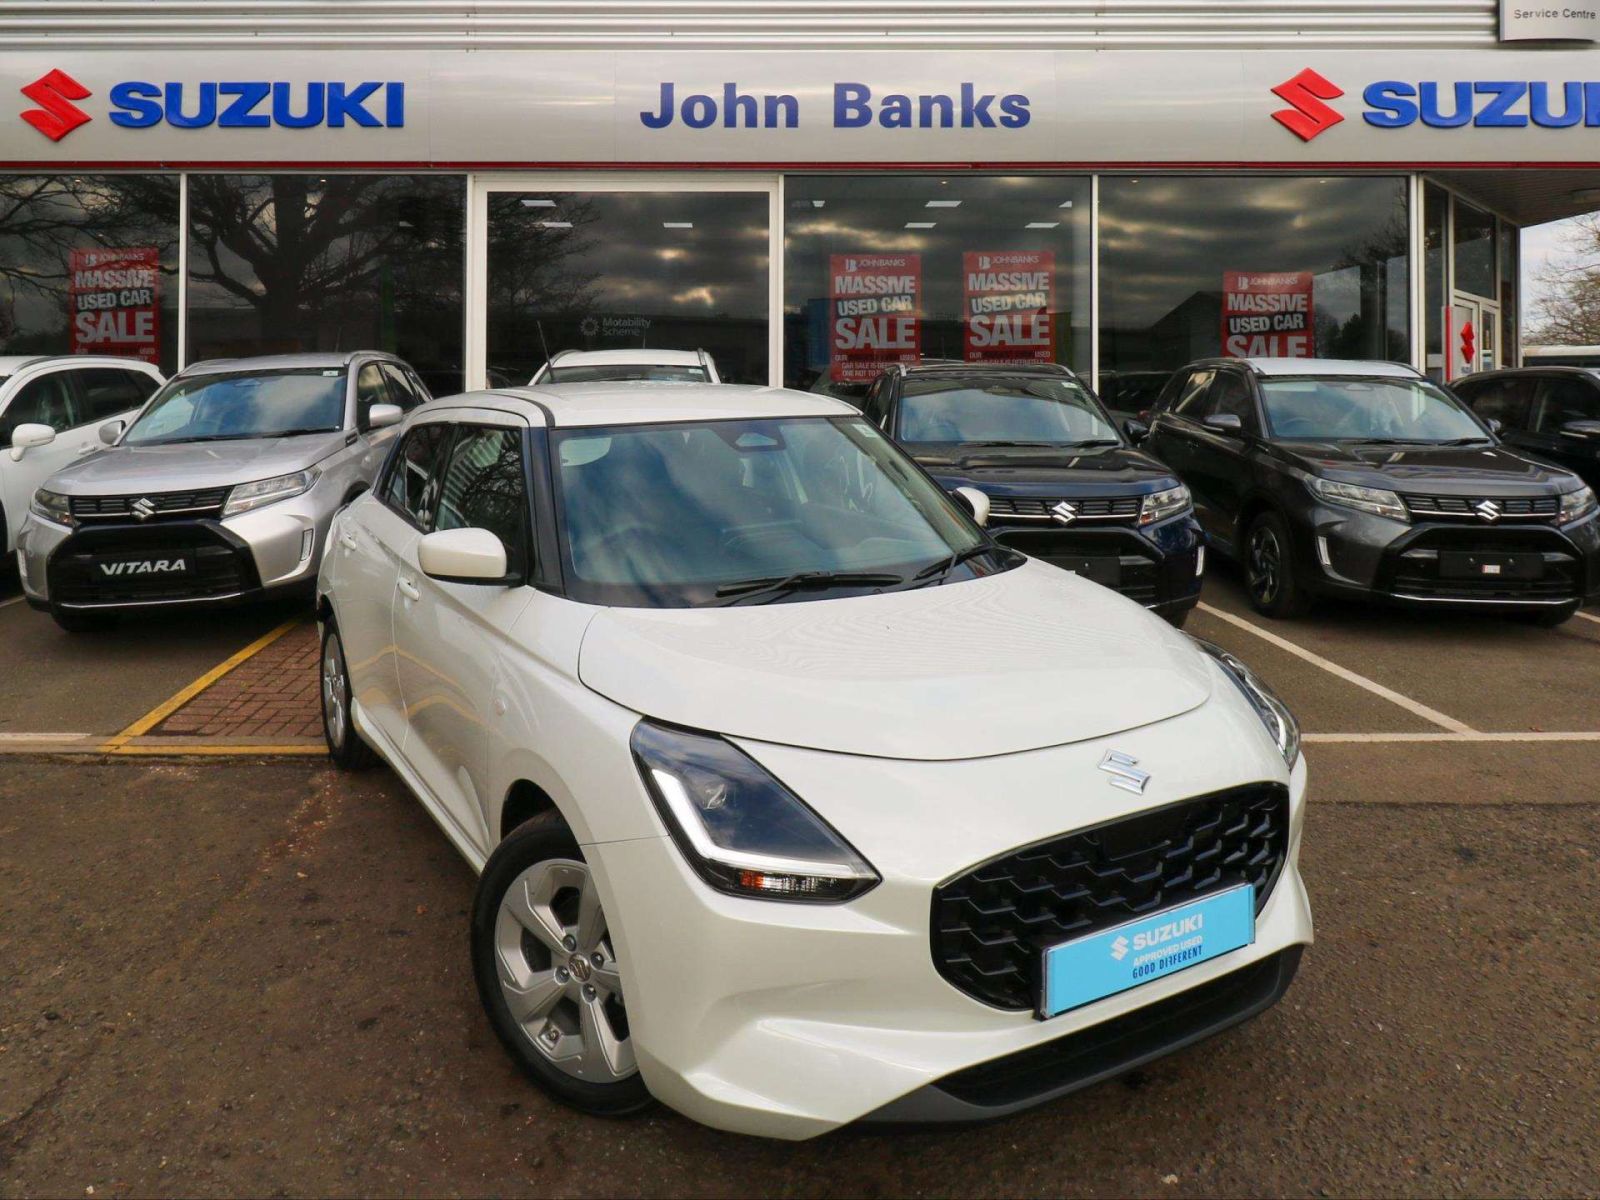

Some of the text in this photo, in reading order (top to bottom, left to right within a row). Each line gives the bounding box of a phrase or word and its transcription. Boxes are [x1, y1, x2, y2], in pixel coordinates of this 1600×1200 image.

[1513, 8, 1596, 19] Service Centre
[109, 81, 404, 128] SUZUKI
[640, 82, 1031, 128] John Banks
[1362, 81, 1600, 128] SUZU
[75, 269, 155, 289] MASSIVE
[835, 276, 916, 293] MASSIVE
[968, 272, 1050, 291] MASSIVE
[77, 289, 151, 310] USED CAR
[837, 295, 913, 316] USED CAR
[971, 292, 1047, 314] USED CAR
[1227, 293, 1308, 312] MASSIVE
[75, 311, 155, 343] SALE
[602, 317, 651, 328] Motability
[602, 327, 640, 336] Scheme
[835, 317, 916, 349] SALE
[969, 314, 1050, 347] SALE
[1229, 313, 1304, 334] USED CAR
[100, 559, 186, 575] VITARA
[1132, 913, 1203, 951] SUZUKI
[1132, 962, 1156, 979] GOOD
